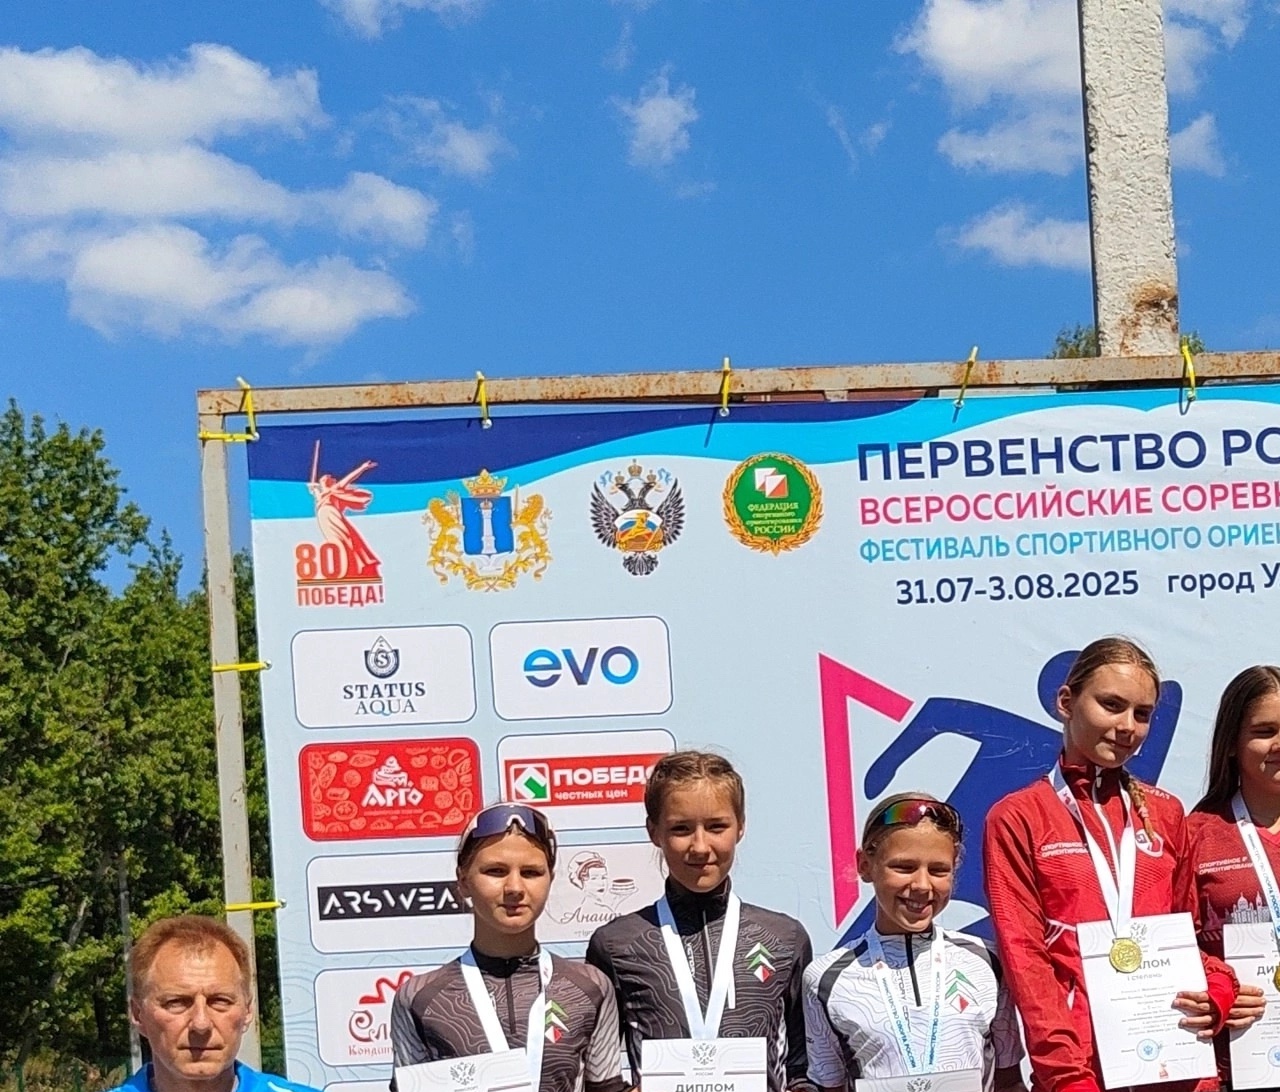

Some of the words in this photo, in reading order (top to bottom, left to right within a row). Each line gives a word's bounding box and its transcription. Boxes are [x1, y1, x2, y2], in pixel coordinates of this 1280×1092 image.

[857, 430, 1207, 481] ПЕРВЕНСТВО
[859, 484, 1152, 526] ВСЕРОССИЙСКИЕ
[754, 525, 796, 535] РОССИИ
[859, 534, 1010, 564] ФЕСТИВАЛЬ
[1015, 526, 1202, 558] СПОРТИВНОГО
[295, 542, 348, 580] 80
[297, 585, 384, 608] ПОБЕДА!
[896, 570, 1139, 605] 31.07-3.08.2025
[1167, 568, 1255, 598] город
[523, 646, 640, 688] evo
[343, 682, 426, 701] STATUS
[355, 699, 417, 717] AQUA
[556, 790, 604, 801] честных
[607, 788, 628, 801] цен
[323, 888, 474, 916] ARSWEA
